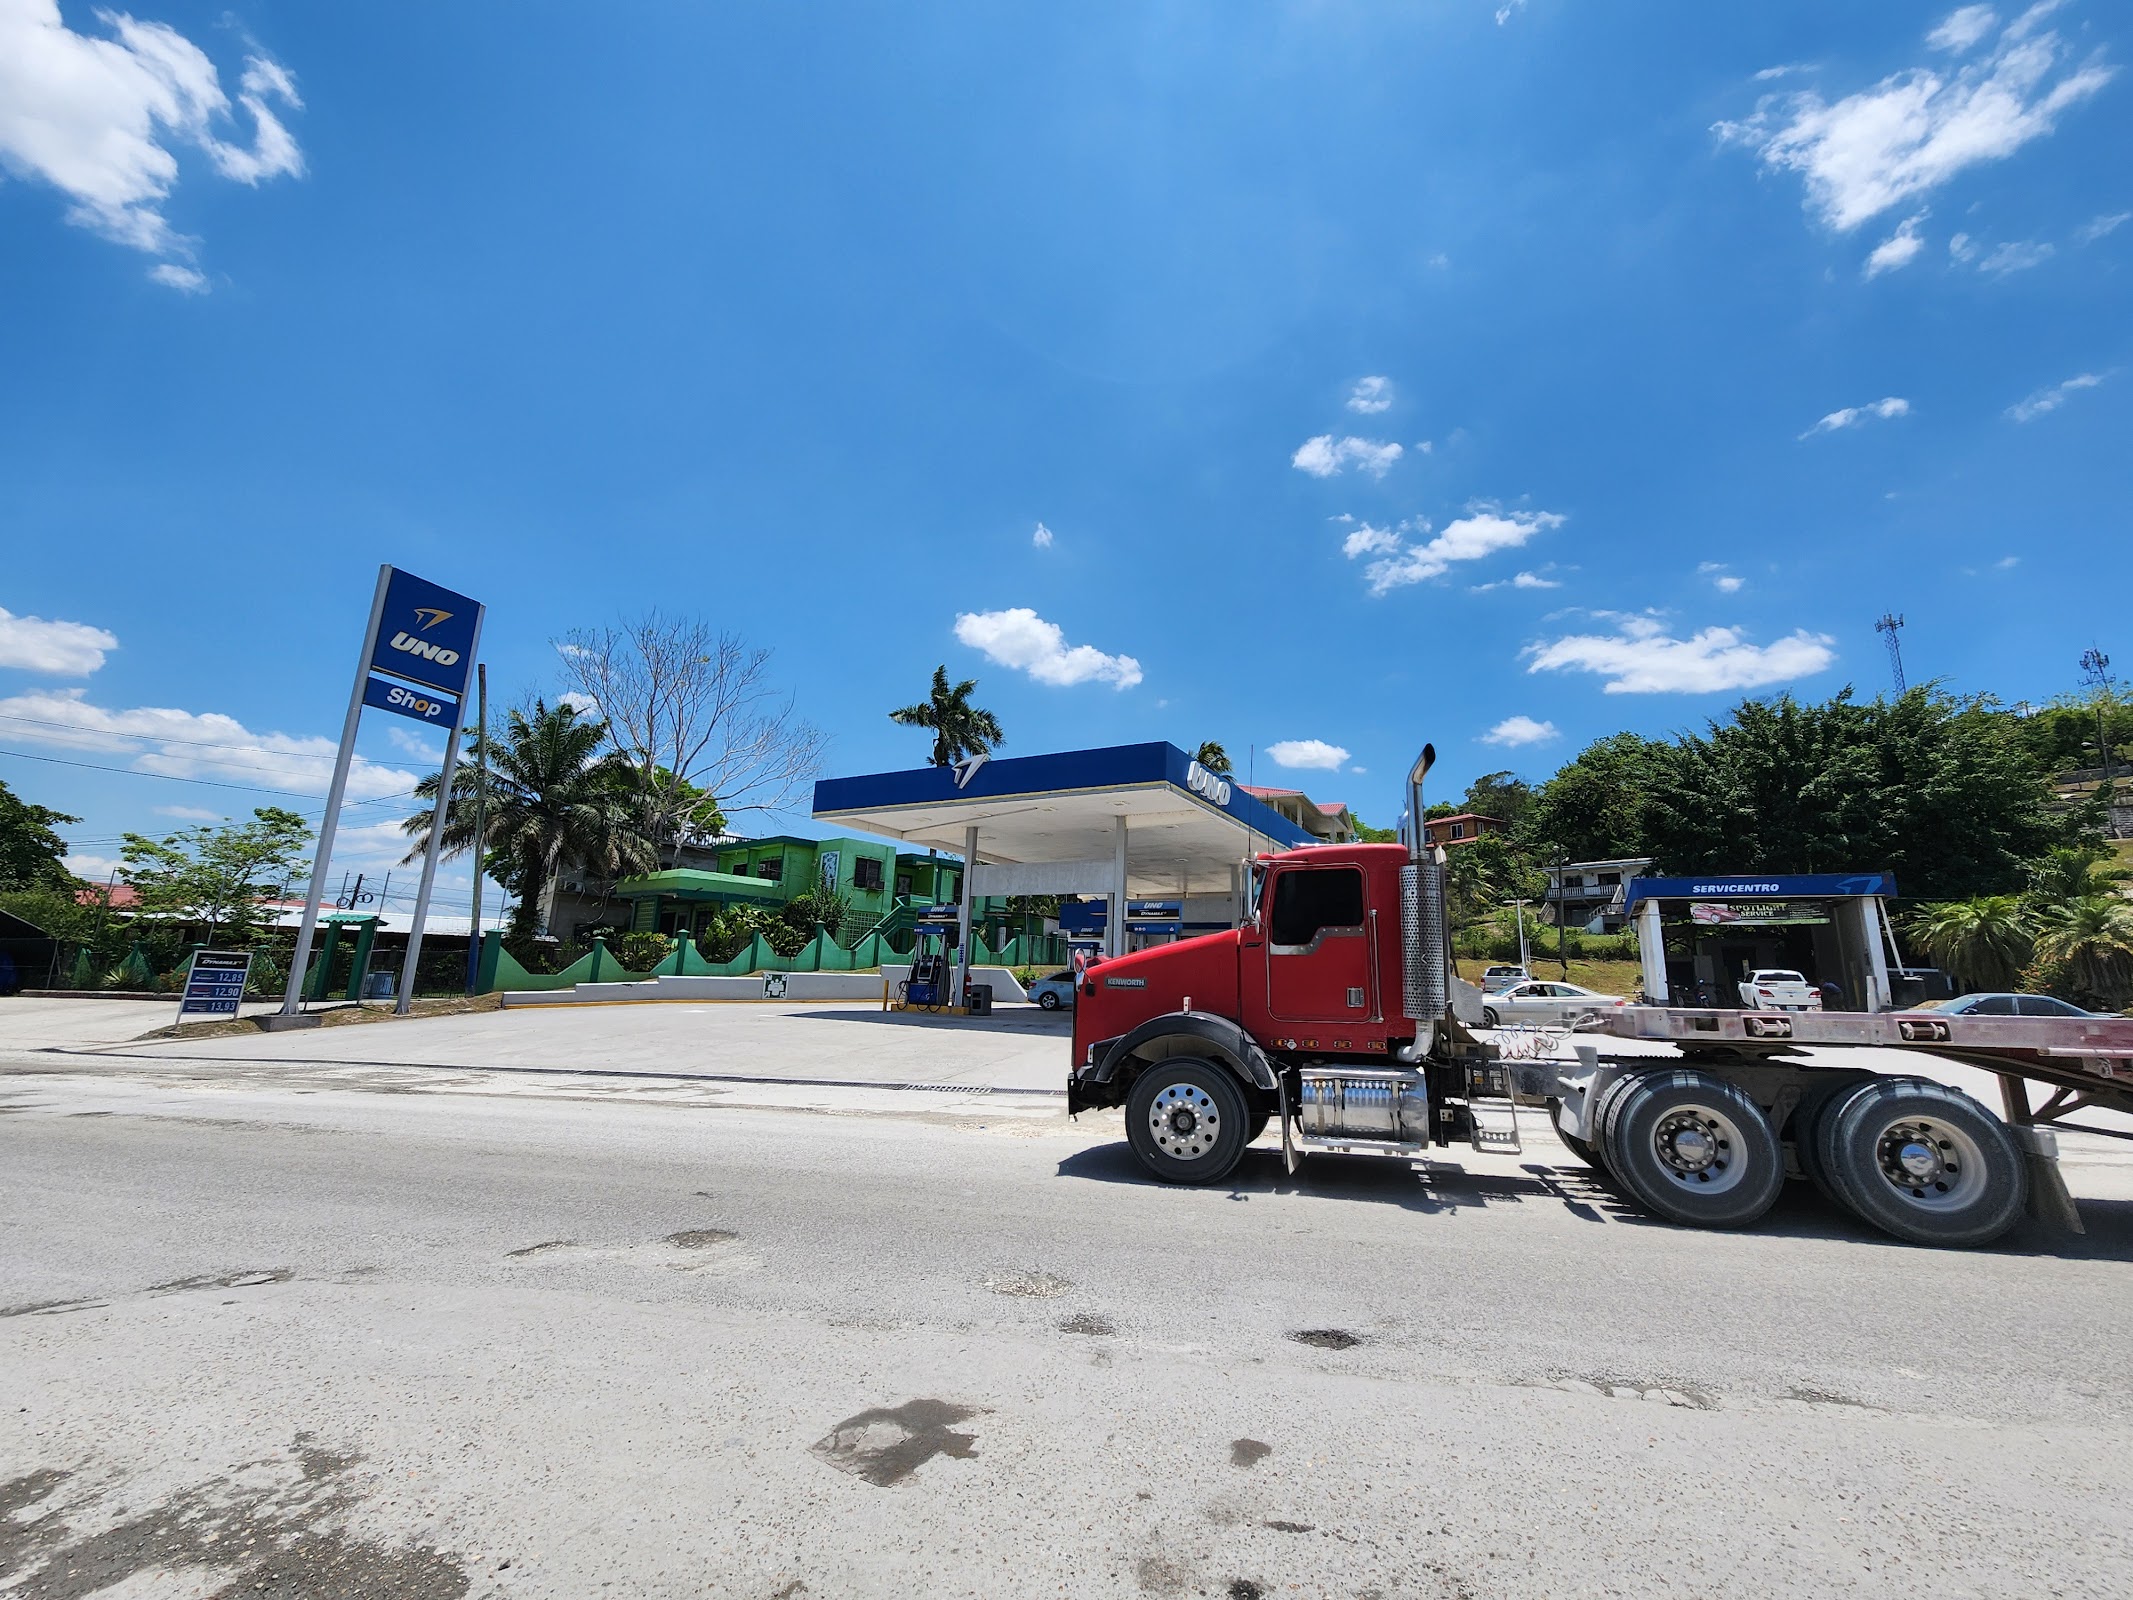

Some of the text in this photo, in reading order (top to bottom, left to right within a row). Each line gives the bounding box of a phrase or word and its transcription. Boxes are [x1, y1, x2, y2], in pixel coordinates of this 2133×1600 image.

[390, 631, 460, 666] UNO
[386, 687, 442, 718] Shop
[1186, 760, 1231, 806] UNO
[1692, 883, 1780, 893] SERVICENTRO
[1729, 904, 1787, 912] SPOTLIGHT
[218, 972, 243, 983] 12.85
[1107, 978, 1145, 986] KENWORTH
[215, 987, 240, 997] 12.90
[210, 1002, 236, 1011] 13.93
